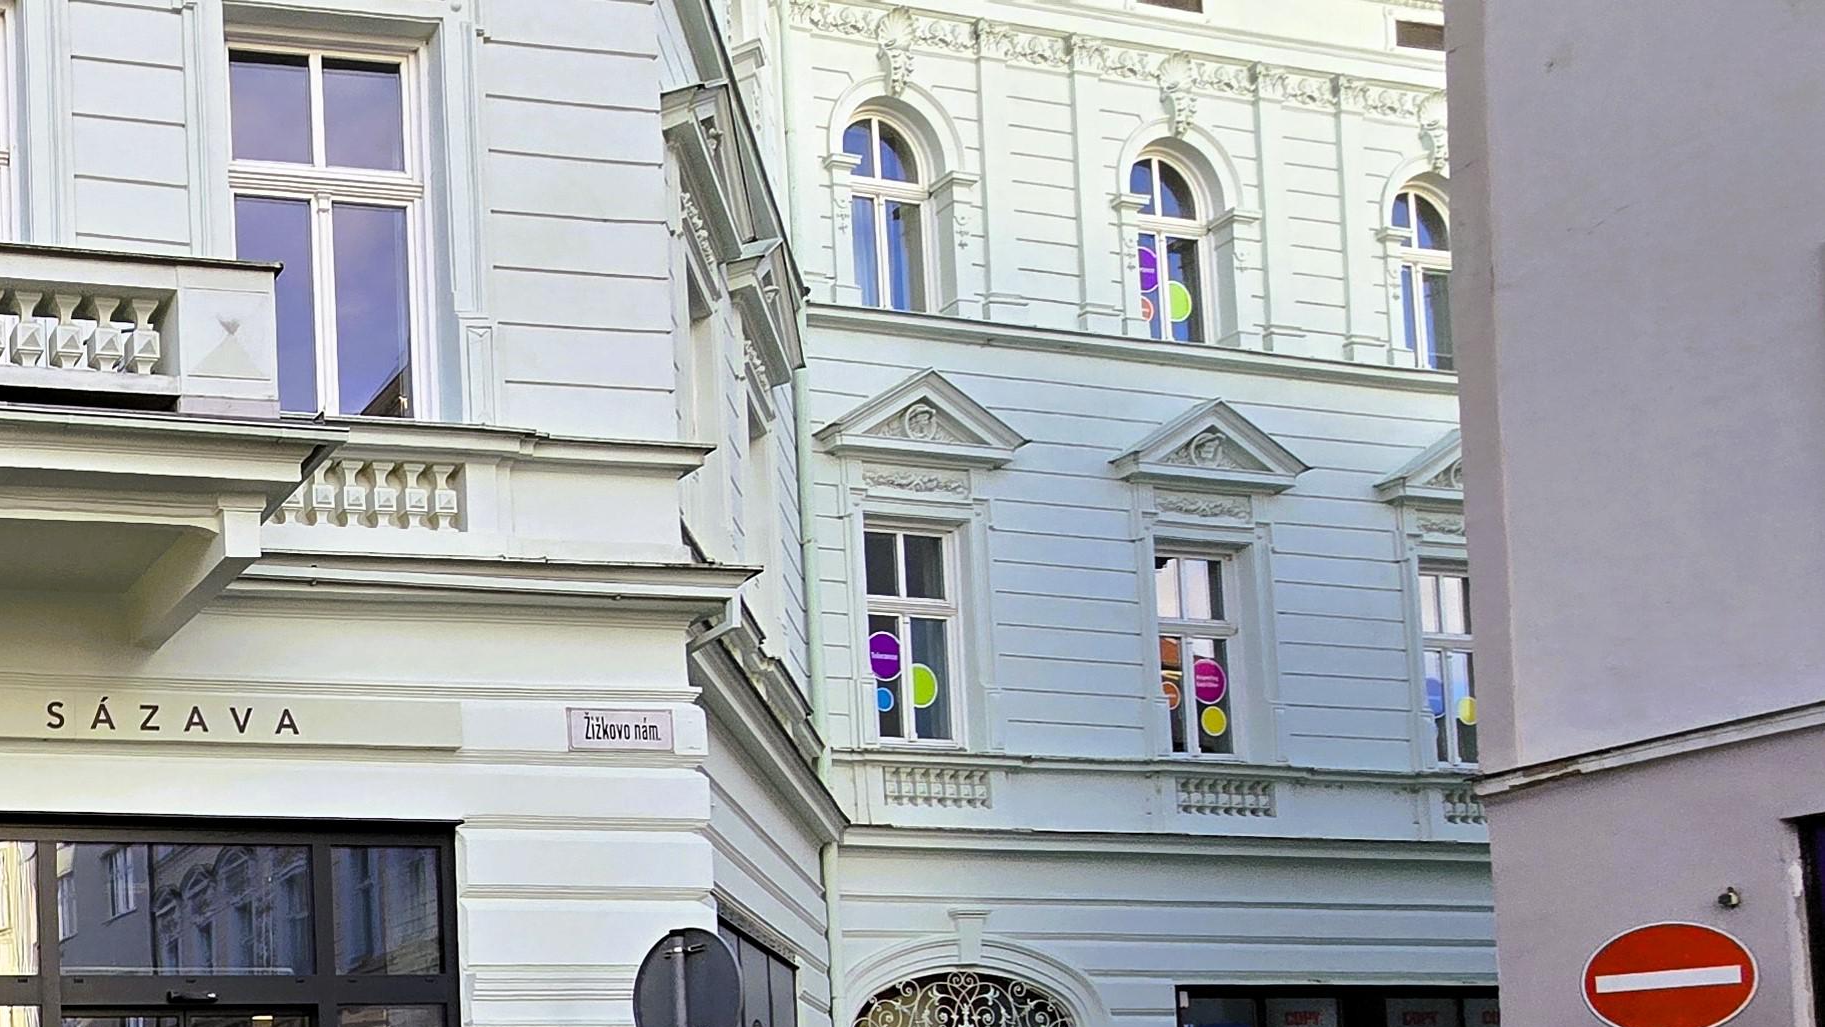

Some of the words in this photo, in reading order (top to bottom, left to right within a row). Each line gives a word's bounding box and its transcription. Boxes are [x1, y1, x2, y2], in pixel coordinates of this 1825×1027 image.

[45, 696, 300, 737] SÁZAVA
[584, 711, 630, 740] Žižkovo
[634, 717, 662, 741] nám.
[1285, 1011, 1321, 1026] COPY
